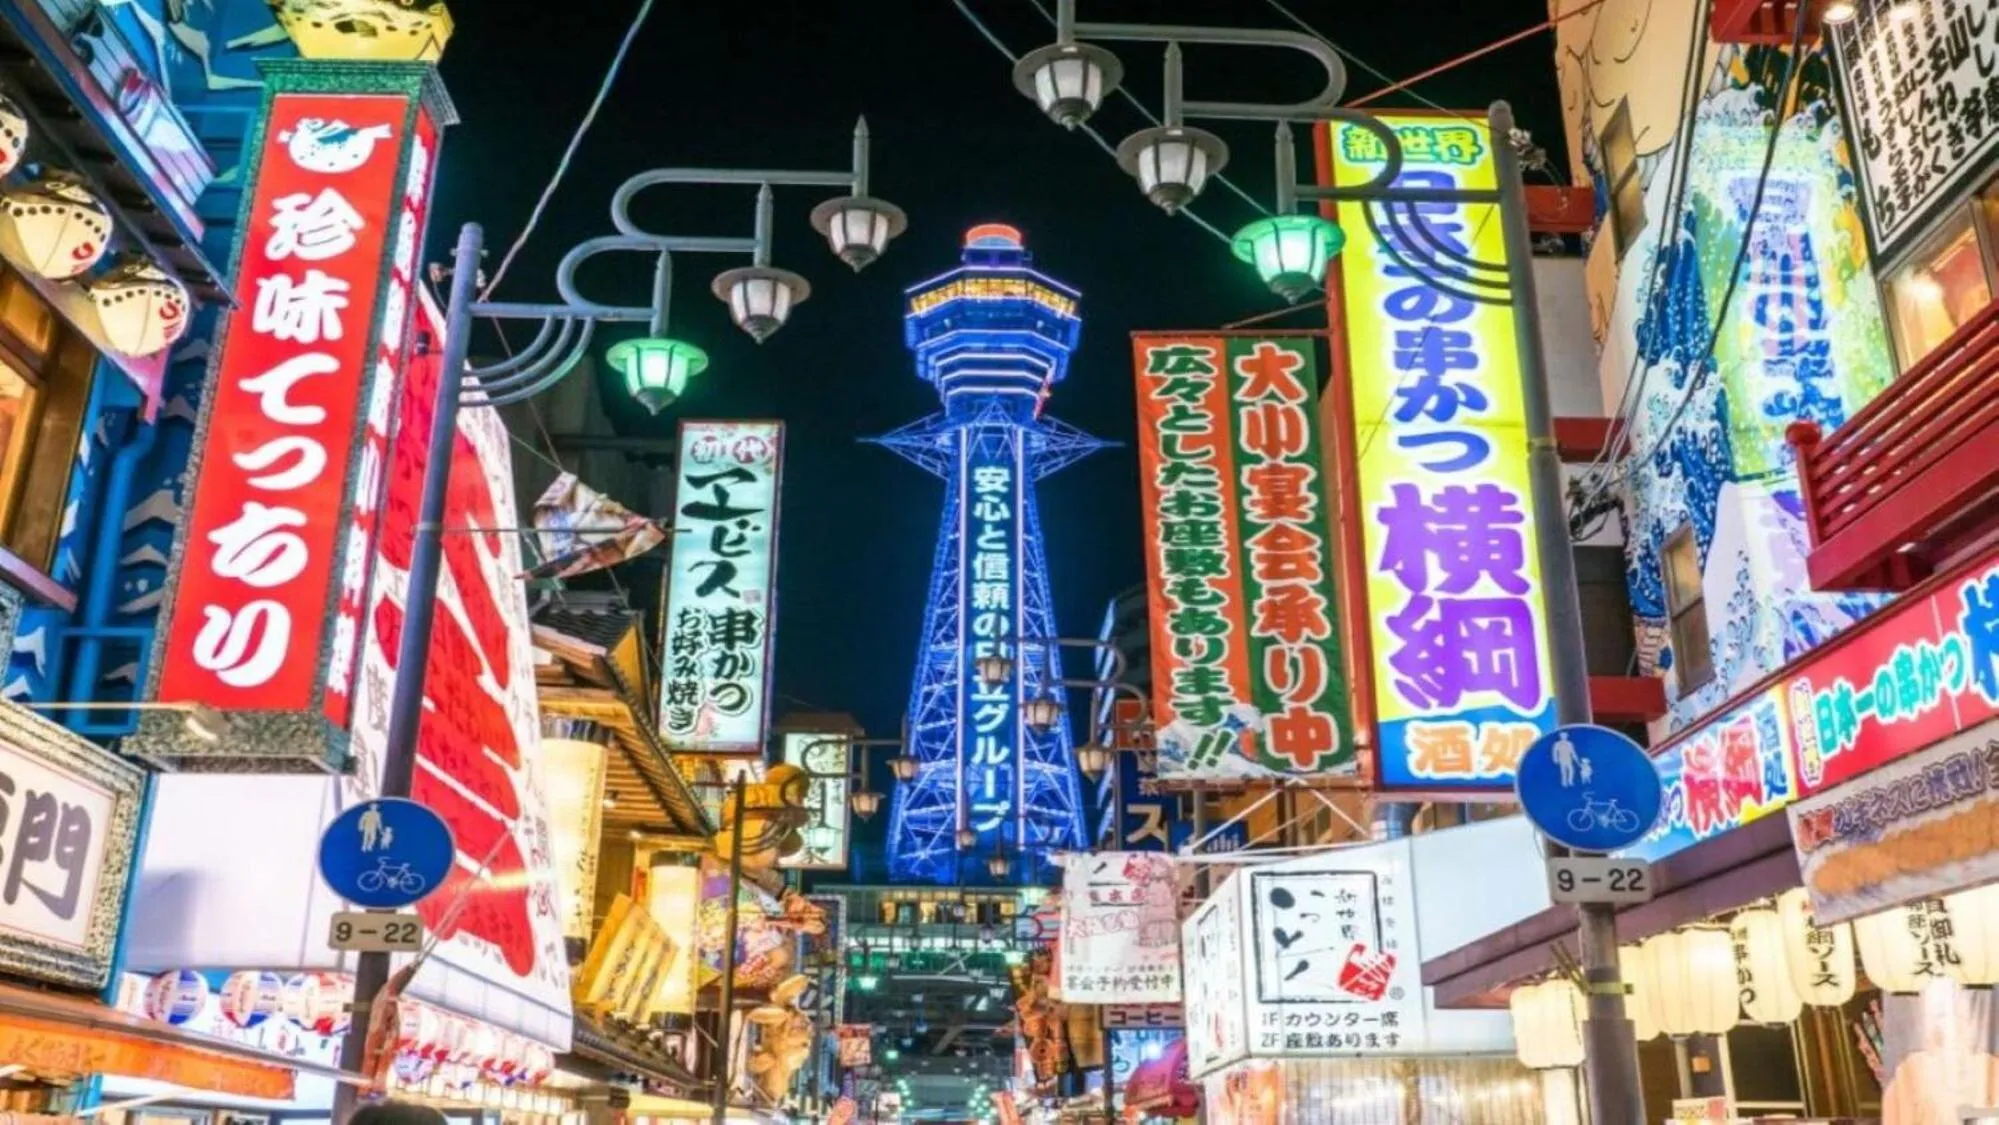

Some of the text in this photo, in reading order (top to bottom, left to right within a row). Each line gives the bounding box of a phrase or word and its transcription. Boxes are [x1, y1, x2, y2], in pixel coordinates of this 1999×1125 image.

[1910, 58, 1947, 174] にんにく
[1342, 126, 1483, 165] 新世界
[1237, 343, 1335, 768] 大小宴会承り中
[1377, 483, 1541, 710] 横綱
[666, 607, 703, 732] お好み焼き
[707, 607, 758, 712] 串かつ
[1814, 637, 1965, 757] 日本一の串かつ
[1412, 724, 1538, 775] 酒処
[1557, 868, 1645, 892] 9-22
[336, 922, 418, 943] 9-22
[1109, 1010, 1180, 1025] コーヒー
[1286, 1011, 1399, 1027] カウンター席
[1286, 1033, 1400, 1048] 座敷あります
